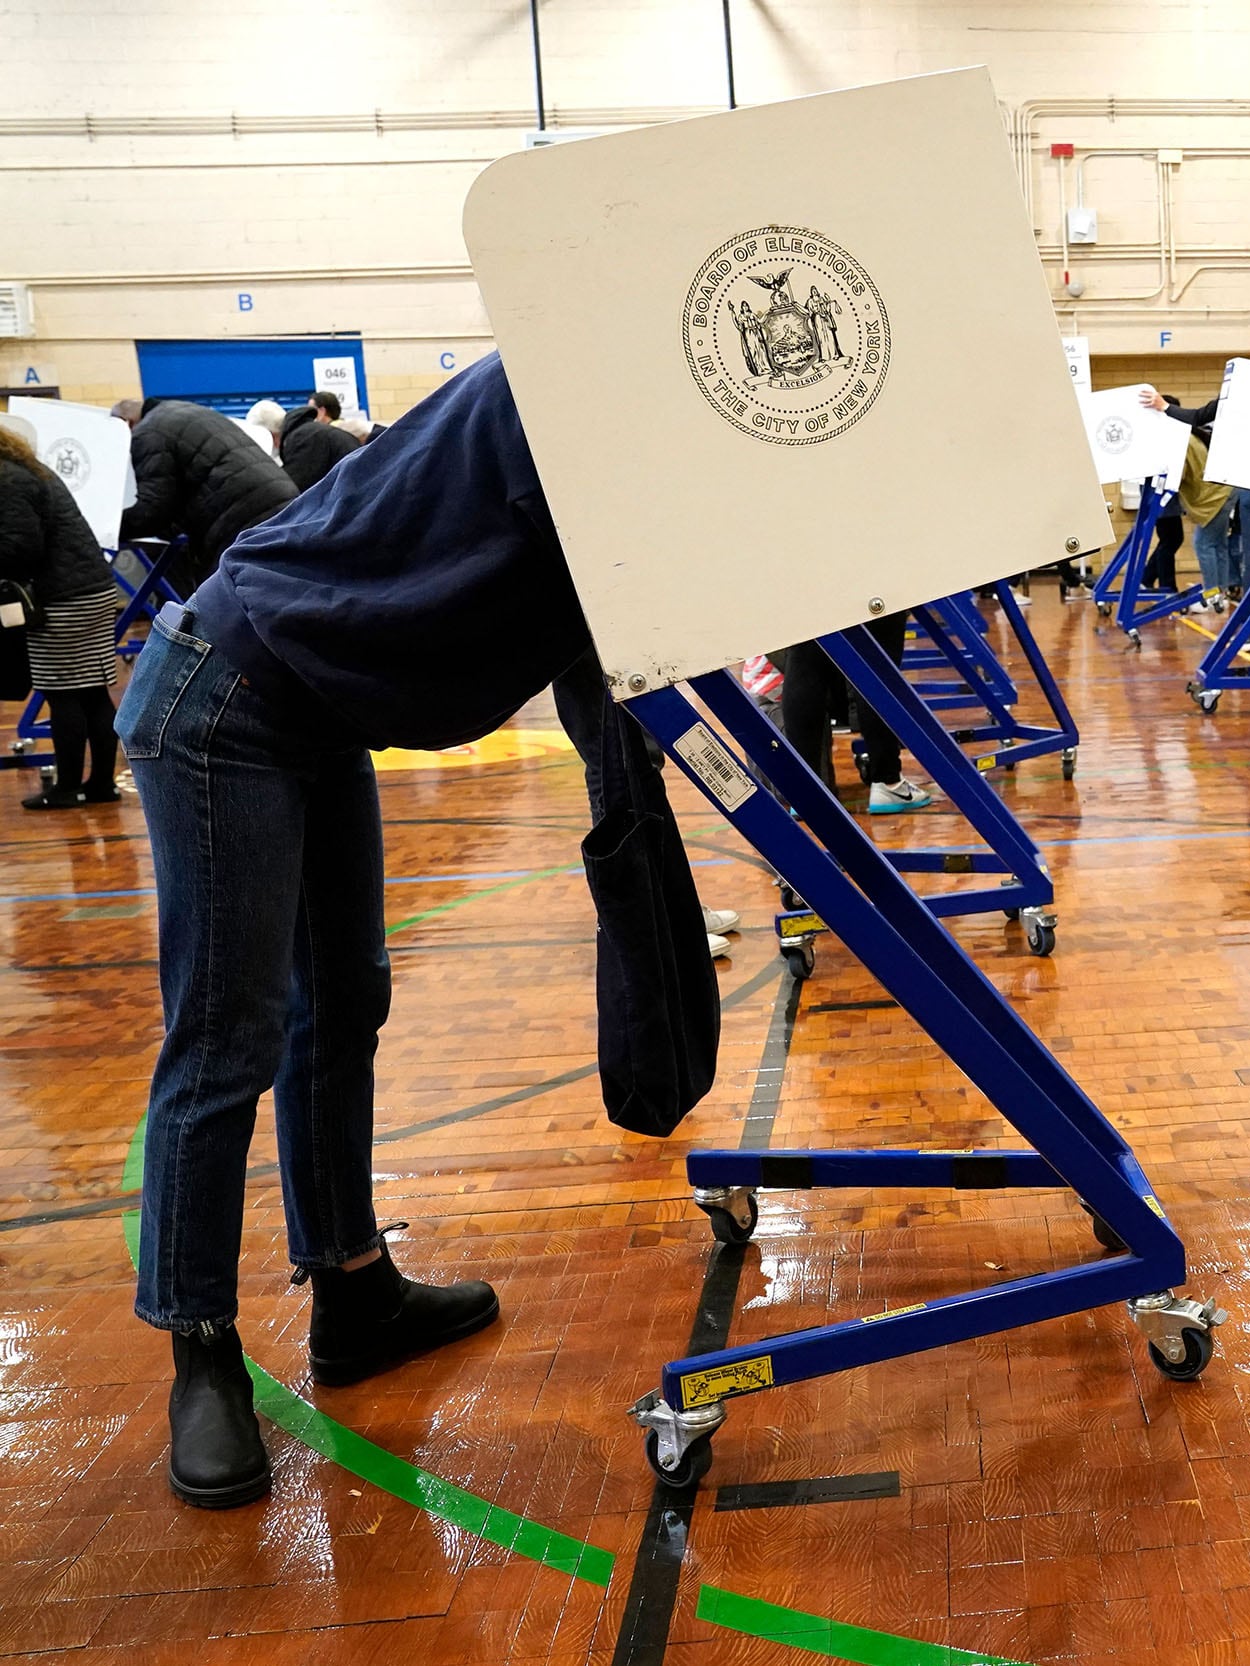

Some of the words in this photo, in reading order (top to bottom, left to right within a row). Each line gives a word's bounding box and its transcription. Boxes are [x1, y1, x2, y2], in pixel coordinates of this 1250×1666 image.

[693, 261, 732, 328] BOARD
[734, 241, 757, 262] OF
[765, 237, 865, 297] ELECTIONS
[239, 294, 253, 311] B
[1160, 332, 1172, 347] F
[440, 352, 455, 369] C
[25, 367, 40, 384] A
[325, 368, 346, 379] 046
[698, 355, 717, 378] IN
[713, 379, 747, 417] THE
[752, 411, 800, 434] CITY
[805, 412, 829, 433] OF
[833, 380, 869, 420] NEW
[862, 319, 880, 375] YORK
[779, 372, 824, 388] EXCELSIOR
